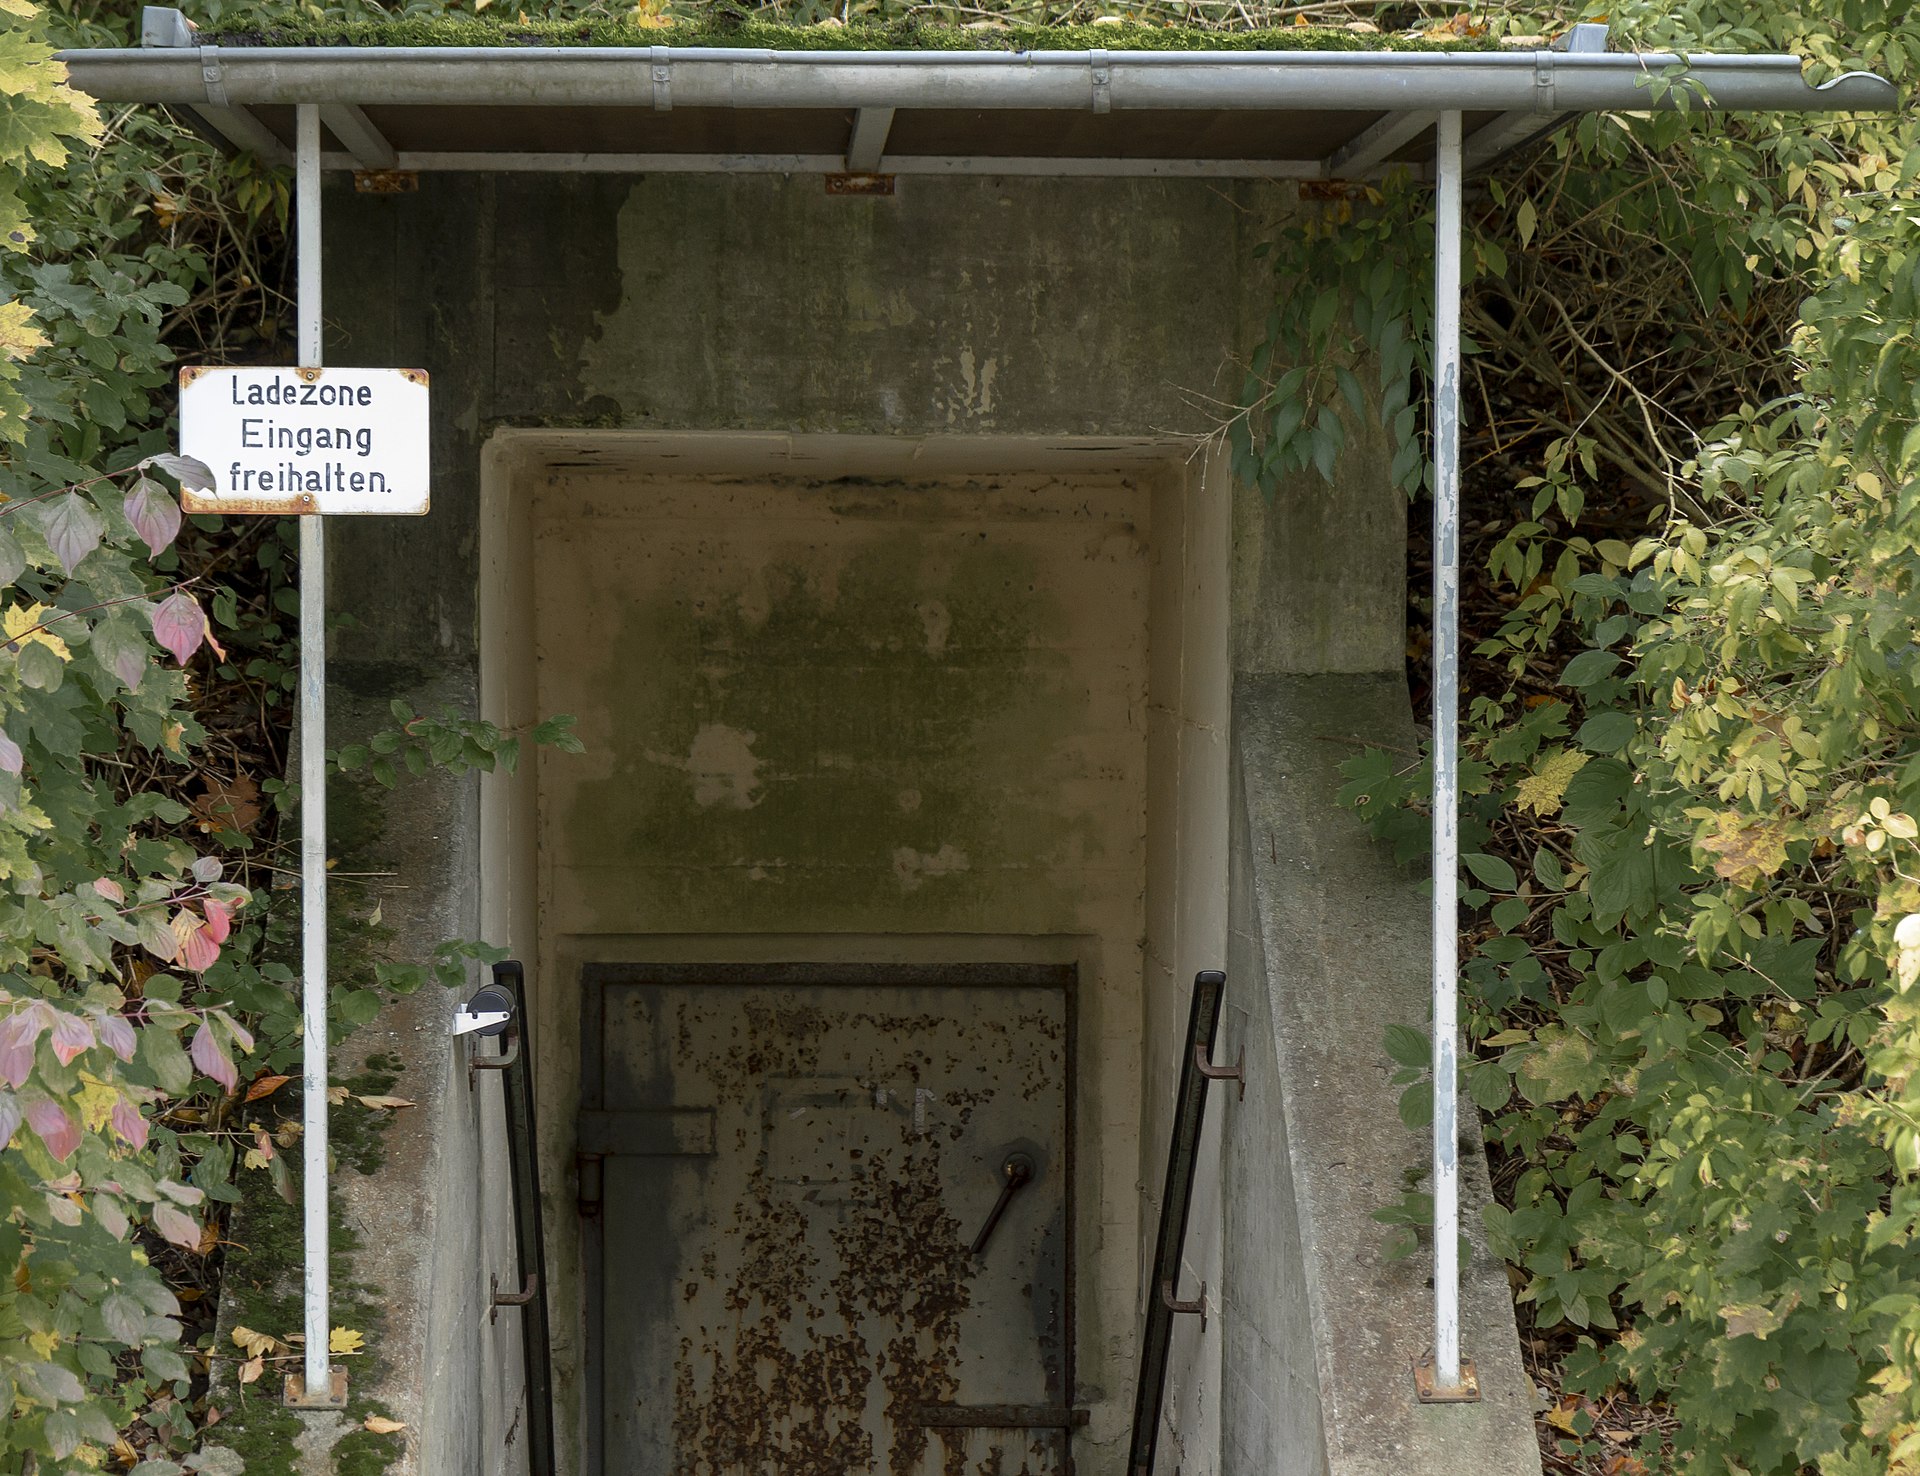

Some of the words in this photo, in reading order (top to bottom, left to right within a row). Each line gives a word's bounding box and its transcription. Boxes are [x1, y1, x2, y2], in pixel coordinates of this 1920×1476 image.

[231, 374, 373, 407] Ladezone
[241, 417, 373, 457] Eingang
[229, 461, 393, 494] freihalten.
